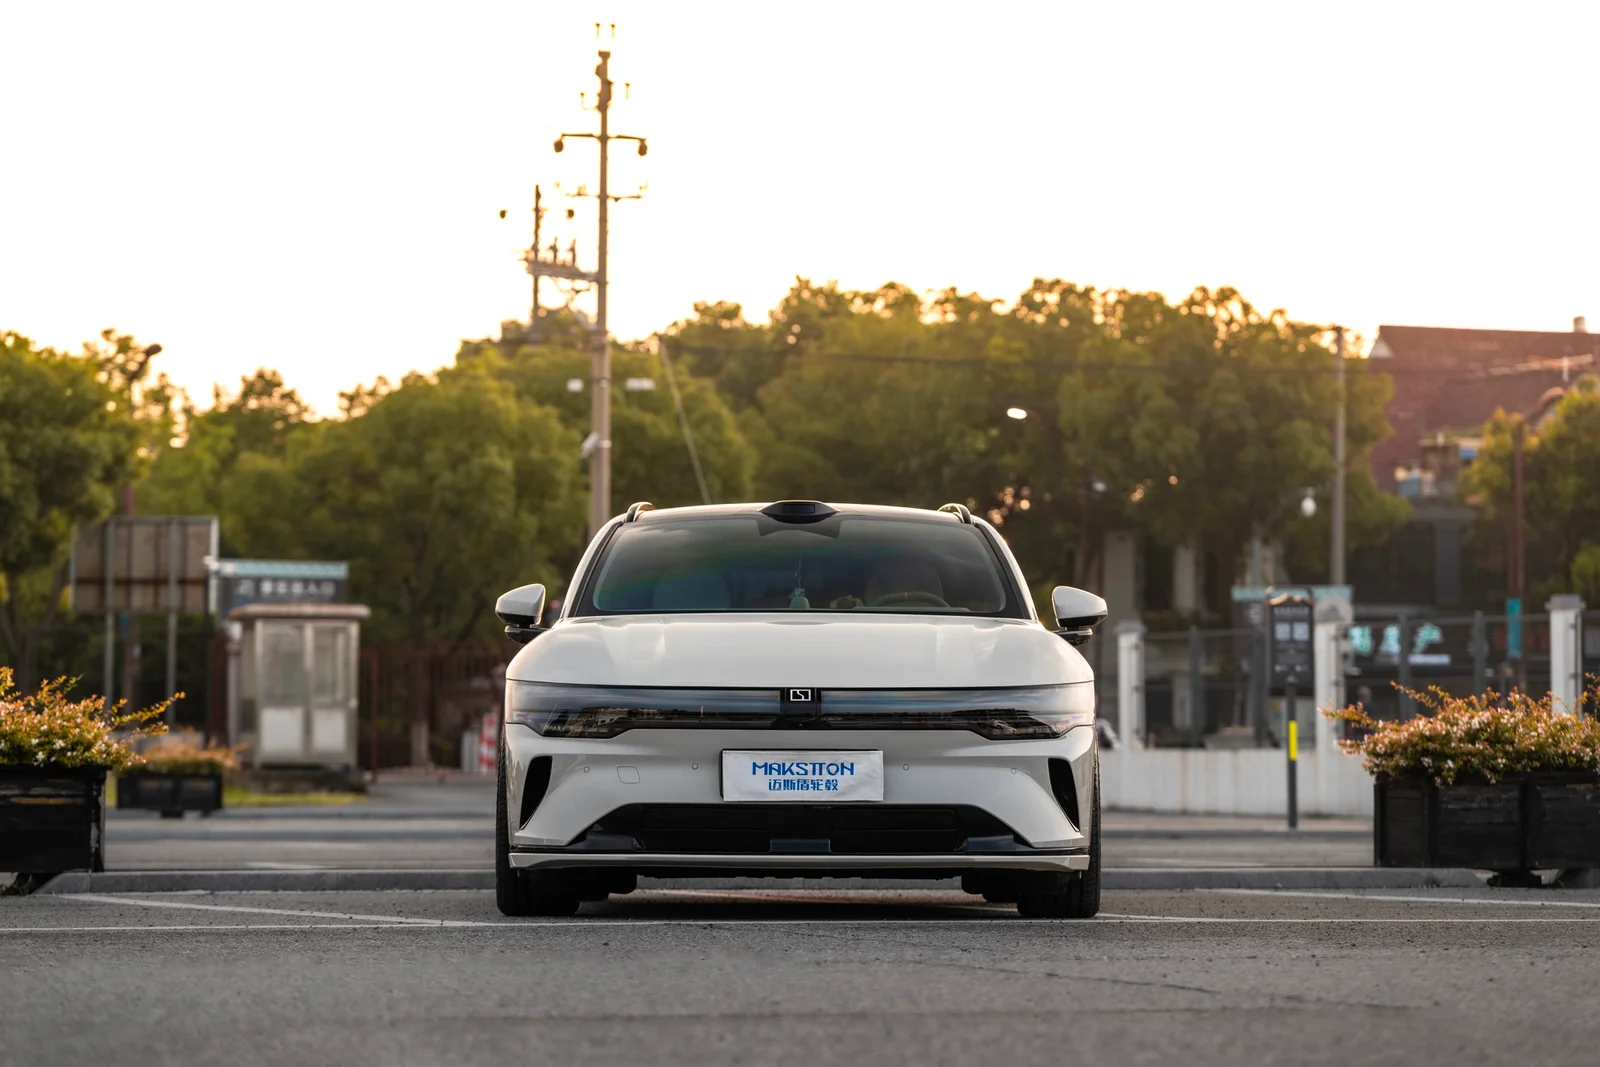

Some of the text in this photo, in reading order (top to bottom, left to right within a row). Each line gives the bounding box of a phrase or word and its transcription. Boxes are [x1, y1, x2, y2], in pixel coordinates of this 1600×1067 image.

[768, 779, 838, 791] 迈斯盾轮毂
